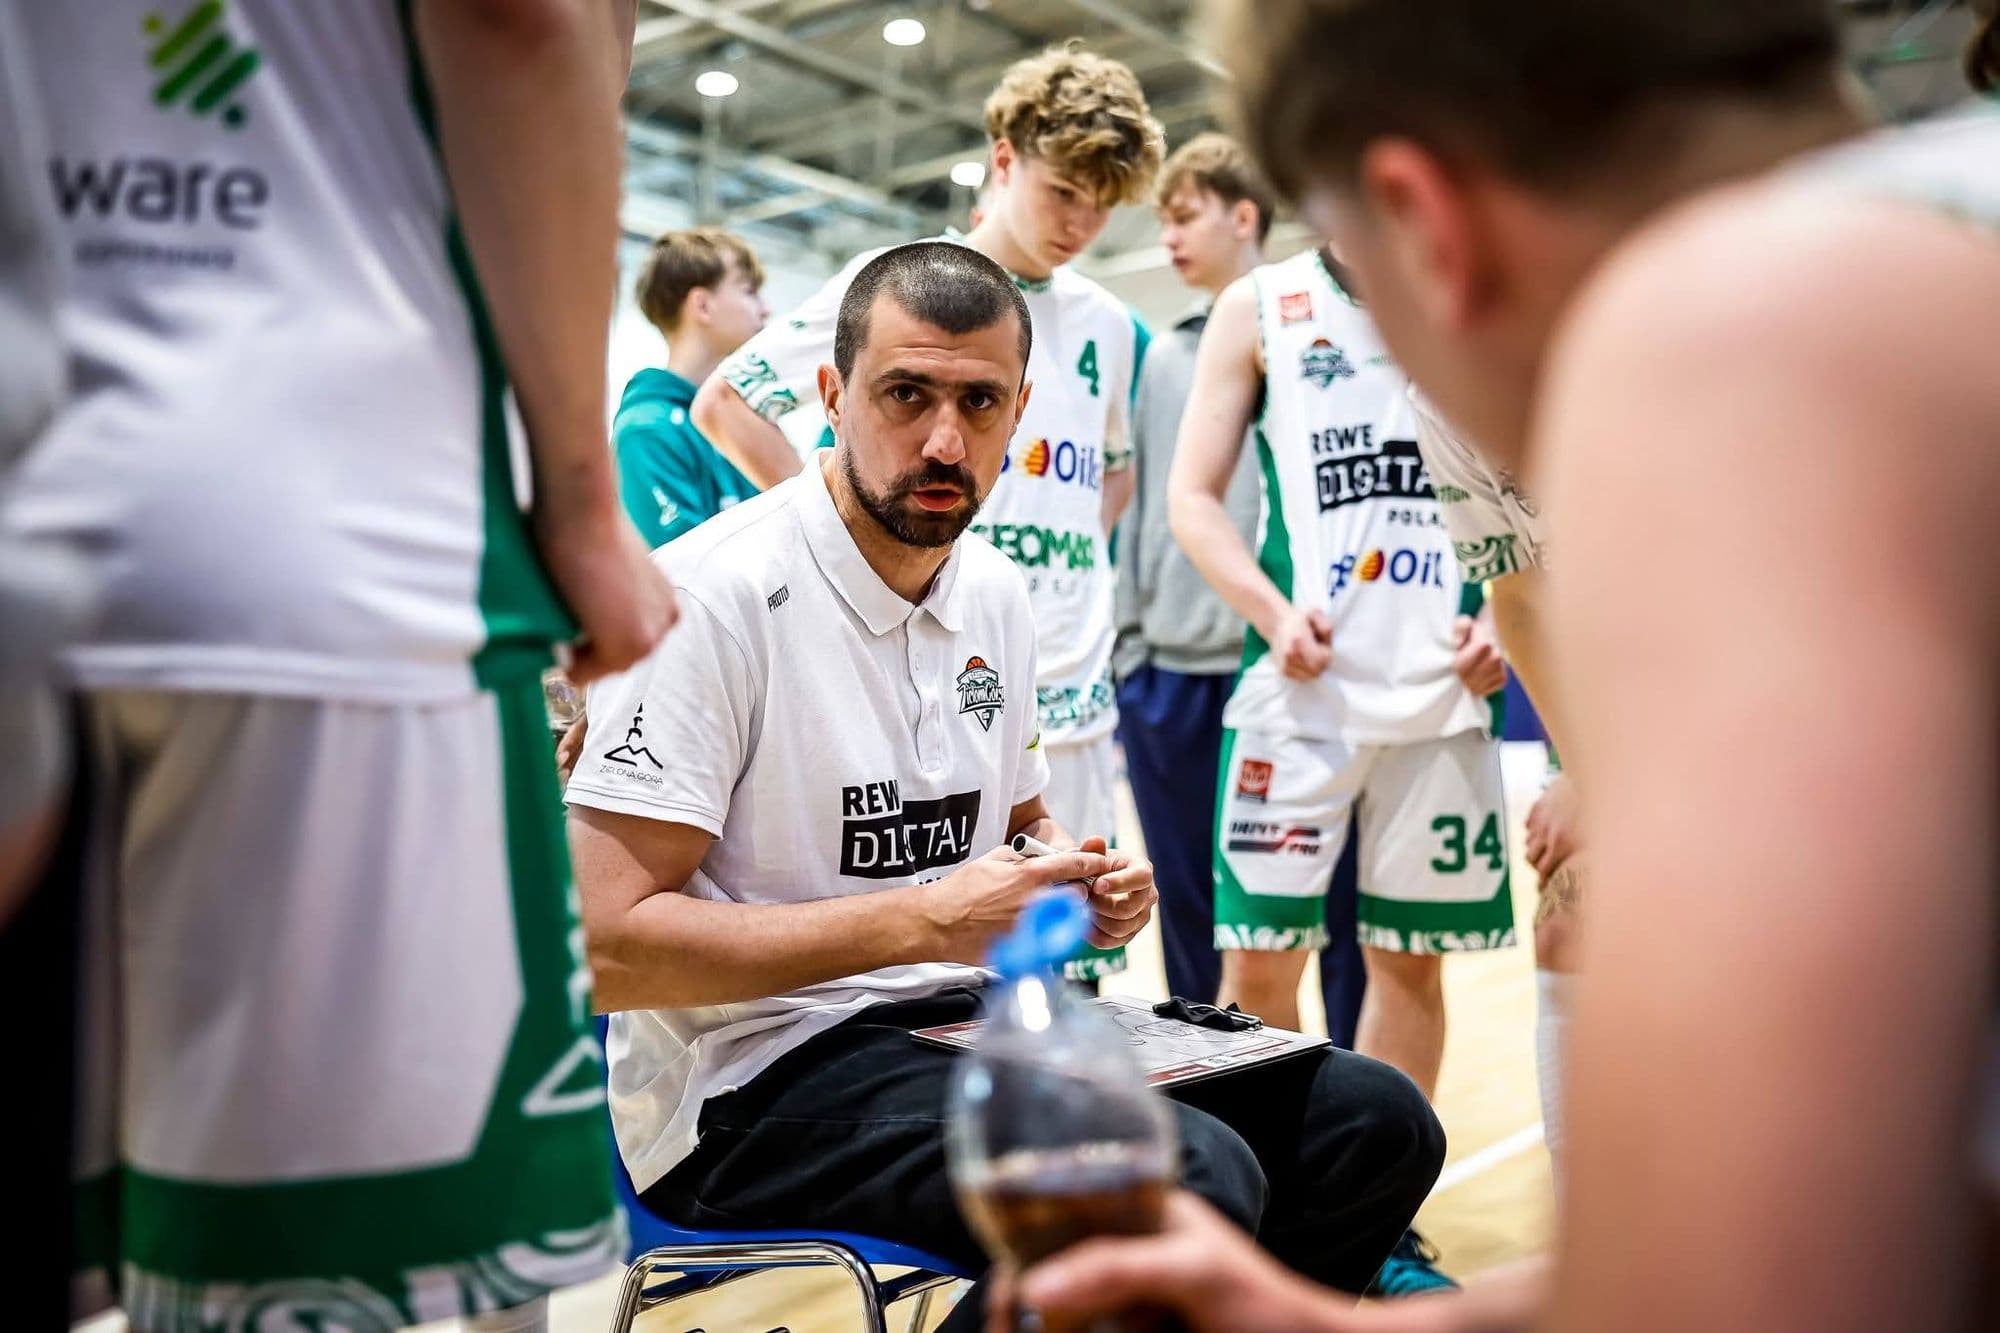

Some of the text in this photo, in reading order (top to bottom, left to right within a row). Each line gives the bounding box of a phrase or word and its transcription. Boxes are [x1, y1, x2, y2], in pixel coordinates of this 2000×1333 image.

[1078, 340, 1099, 396] 4
[1312, 424, 1374, 454] REWE
[1387, 507, 1446, 529] POLA
[842, 779, 900, 817] REW
[1430, 811, 1503, 873] 34
